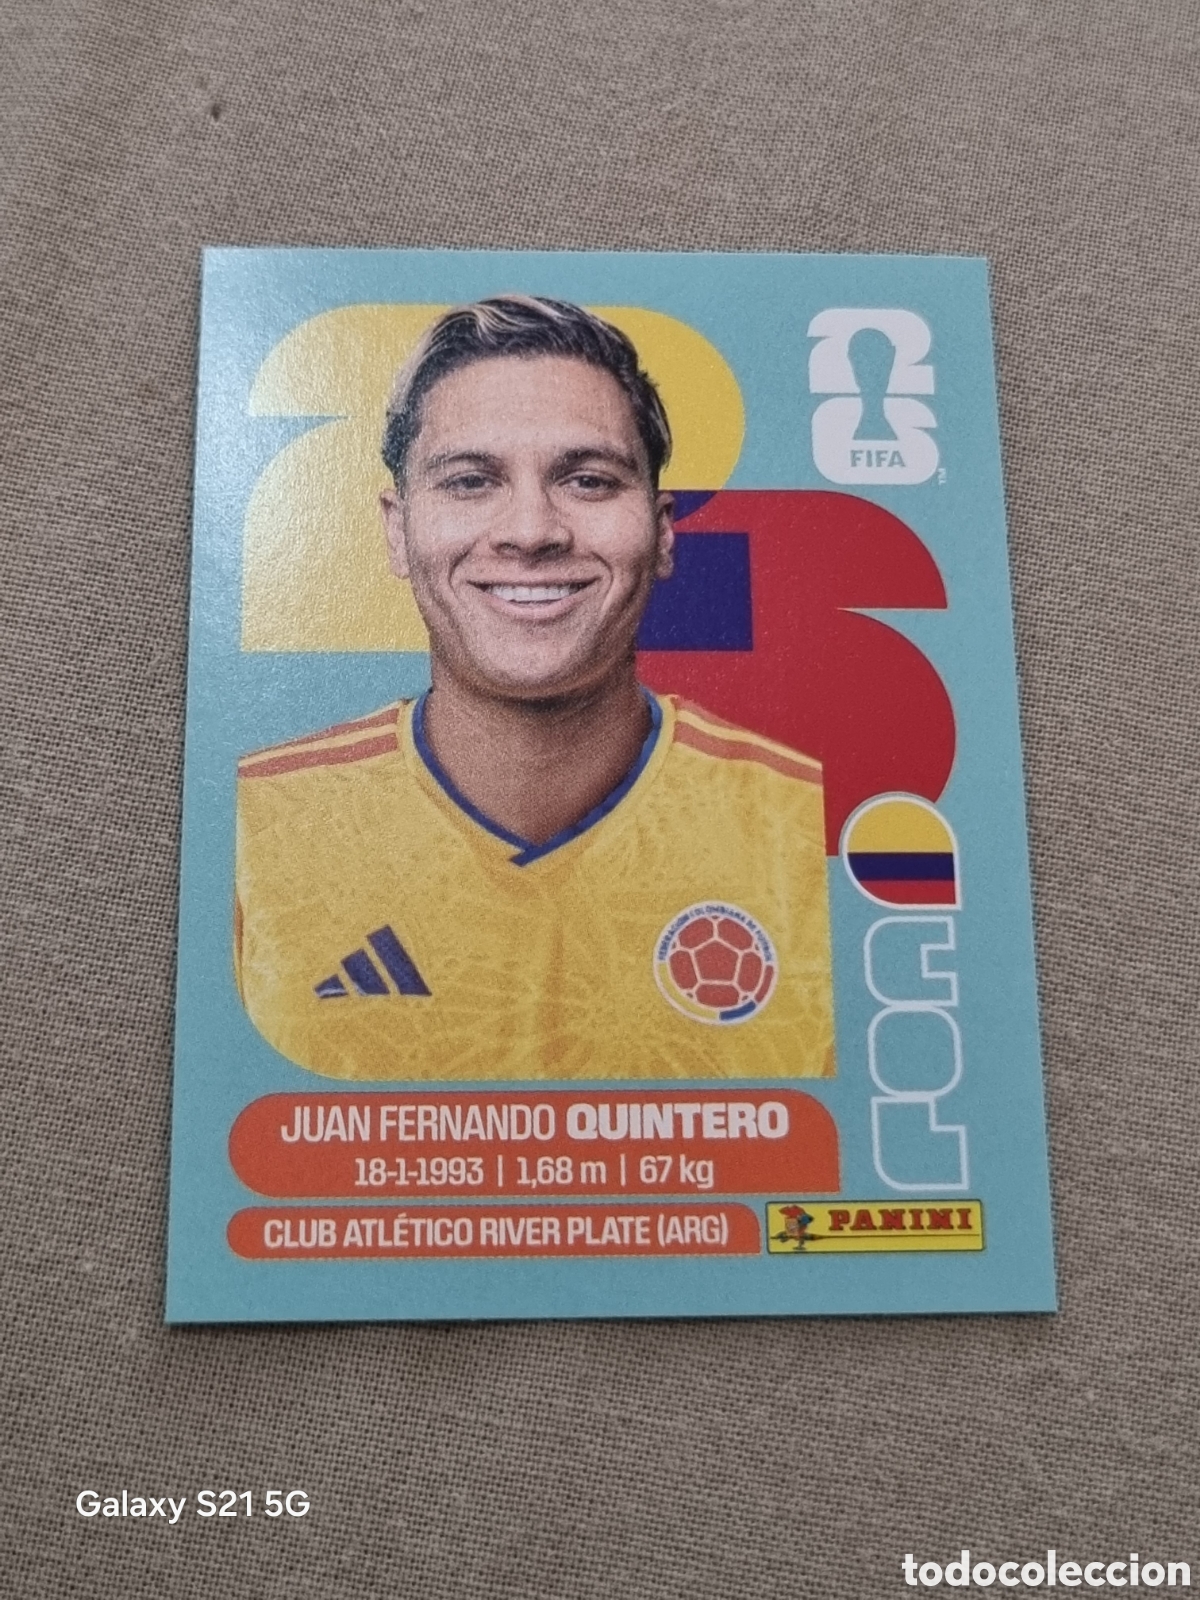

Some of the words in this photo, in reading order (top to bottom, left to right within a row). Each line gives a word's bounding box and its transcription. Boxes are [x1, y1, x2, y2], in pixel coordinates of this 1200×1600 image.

[850, 450, 906, 467] FIFA
[864, 916, 969, 1190] COL
[281, 1105, 371, 1142] JUAN
[380, 1104, 555, 1141] FERNANDO
[566, 1102, 790, 1140] QUINTERO
[354, 1157, 484, 1187] 18-1-1993
[517, 1156, 573, 1189] 1,68
[580, 1161, 607, 1184] m
[639, 1155, 671, 1184] 67
[679, 1155, 714, 1189] kg
[263, 1219, 337, 1248] CLUB
[343, 1213, 473, 1247] ATLÉTICO
[480, 1217, 560, 1245] RIVER
[568, 1216, 651, 1245] PLATE
[658, 1213, 728, 1246] (ARG)
[828, 1208, 973, 1231] PANINI
